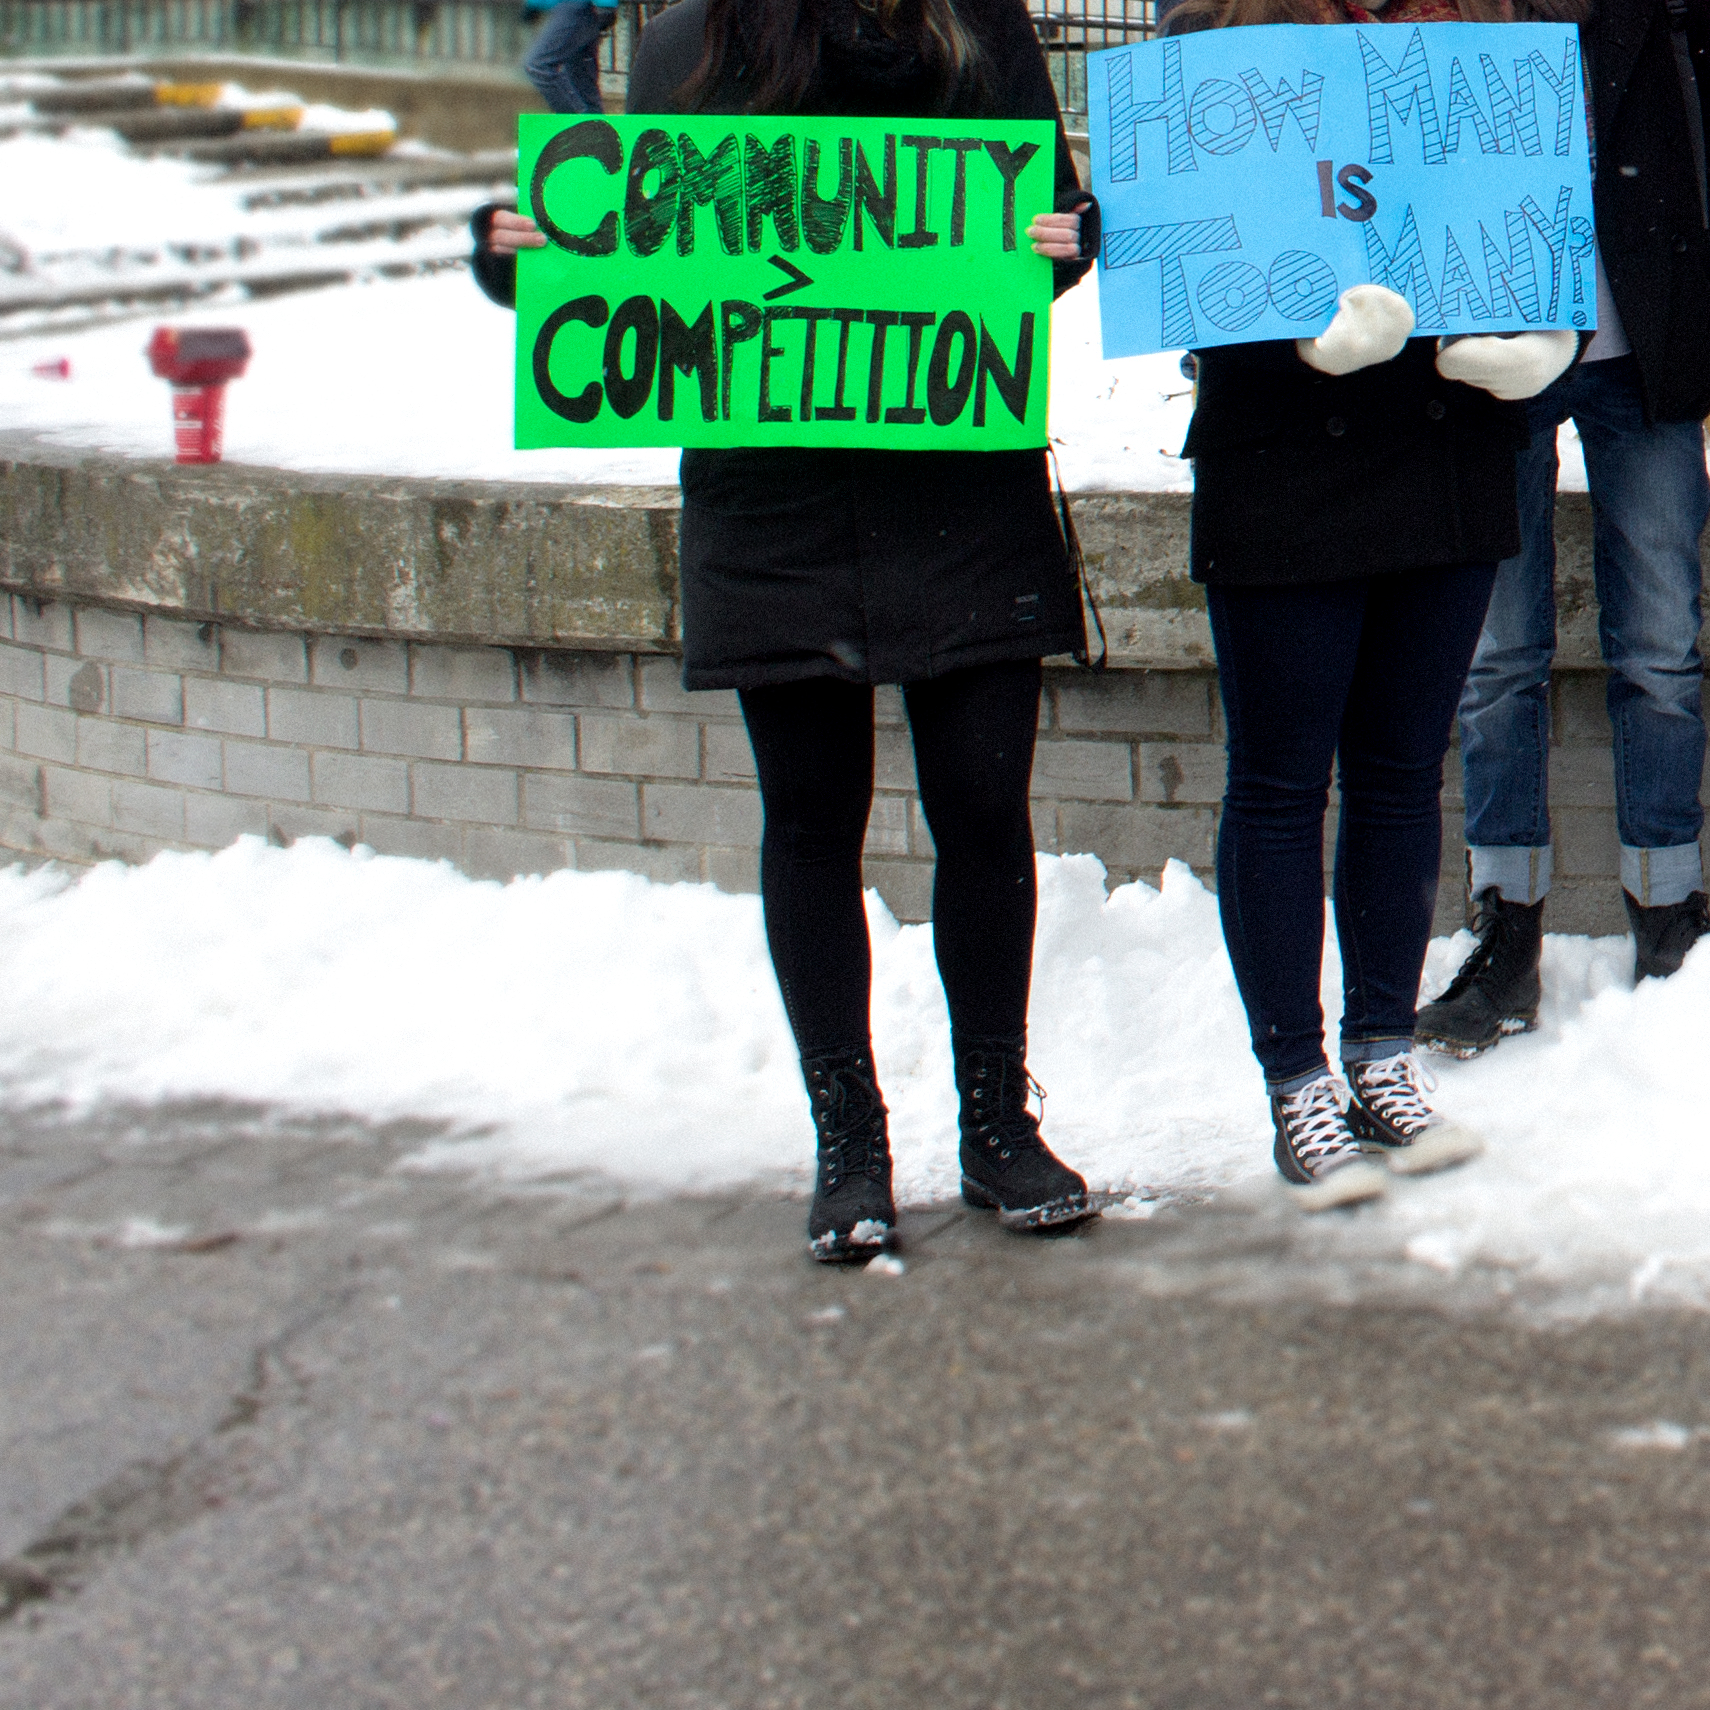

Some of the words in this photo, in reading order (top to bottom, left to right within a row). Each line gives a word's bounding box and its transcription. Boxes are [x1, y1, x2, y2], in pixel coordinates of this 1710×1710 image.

[1105, 40, 1325, 183] HOW
[1356, 26, 1577, 165] MANY
[530, 119, 1041, 257] COMMUNITY
[1317, 160, 1377, 222] IS
[1103, 213, 1338, 347] TOO
[1363, 185, 1596, 330] MANY?
[530, 294, 1035, 428] COMPETITION
